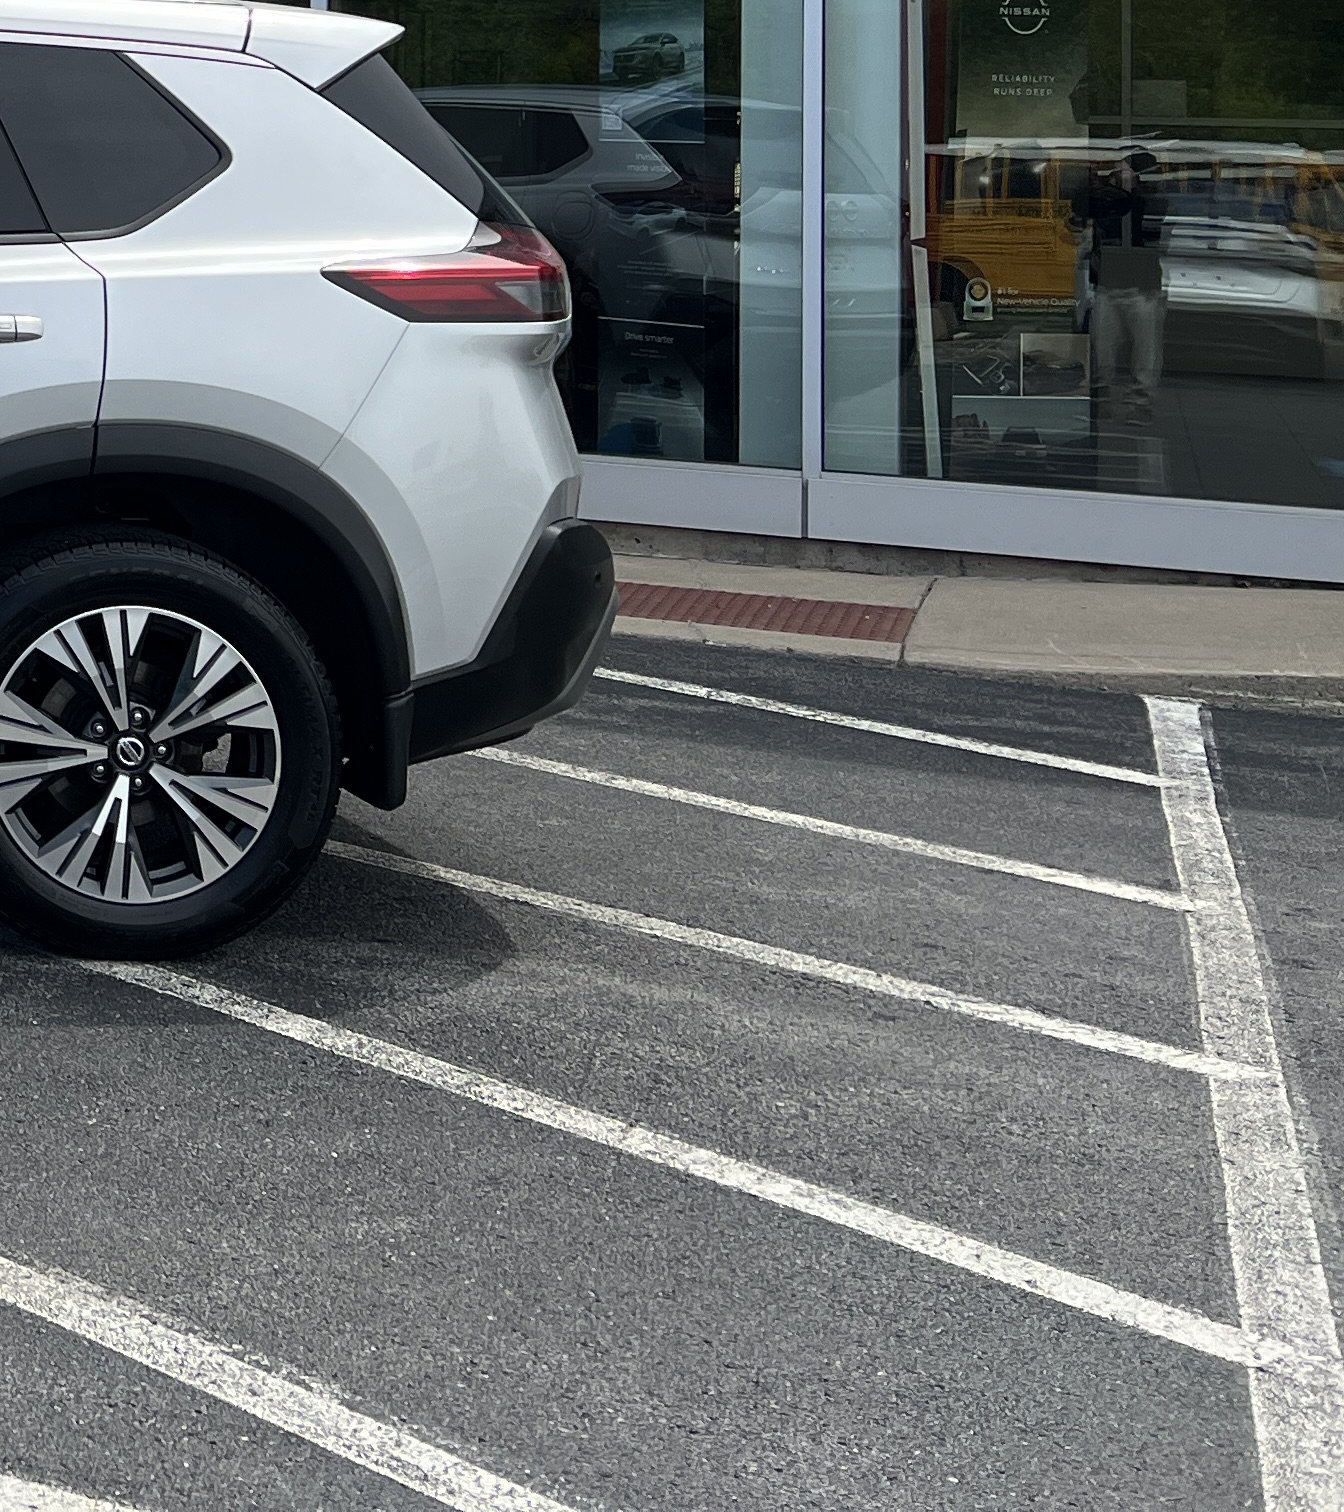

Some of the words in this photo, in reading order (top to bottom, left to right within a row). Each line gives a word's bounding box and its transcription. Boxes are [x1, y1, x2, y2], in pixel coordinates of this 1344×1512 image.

[999, 7, 1050, 16] NISSAN
[992, 74, 1055, 83] RELIABILITY
[993, 88, 1022, 96] RUNS
[1026, 88, 1053, 96] DEEP
[1051, 298, 1081, 307] Quality
